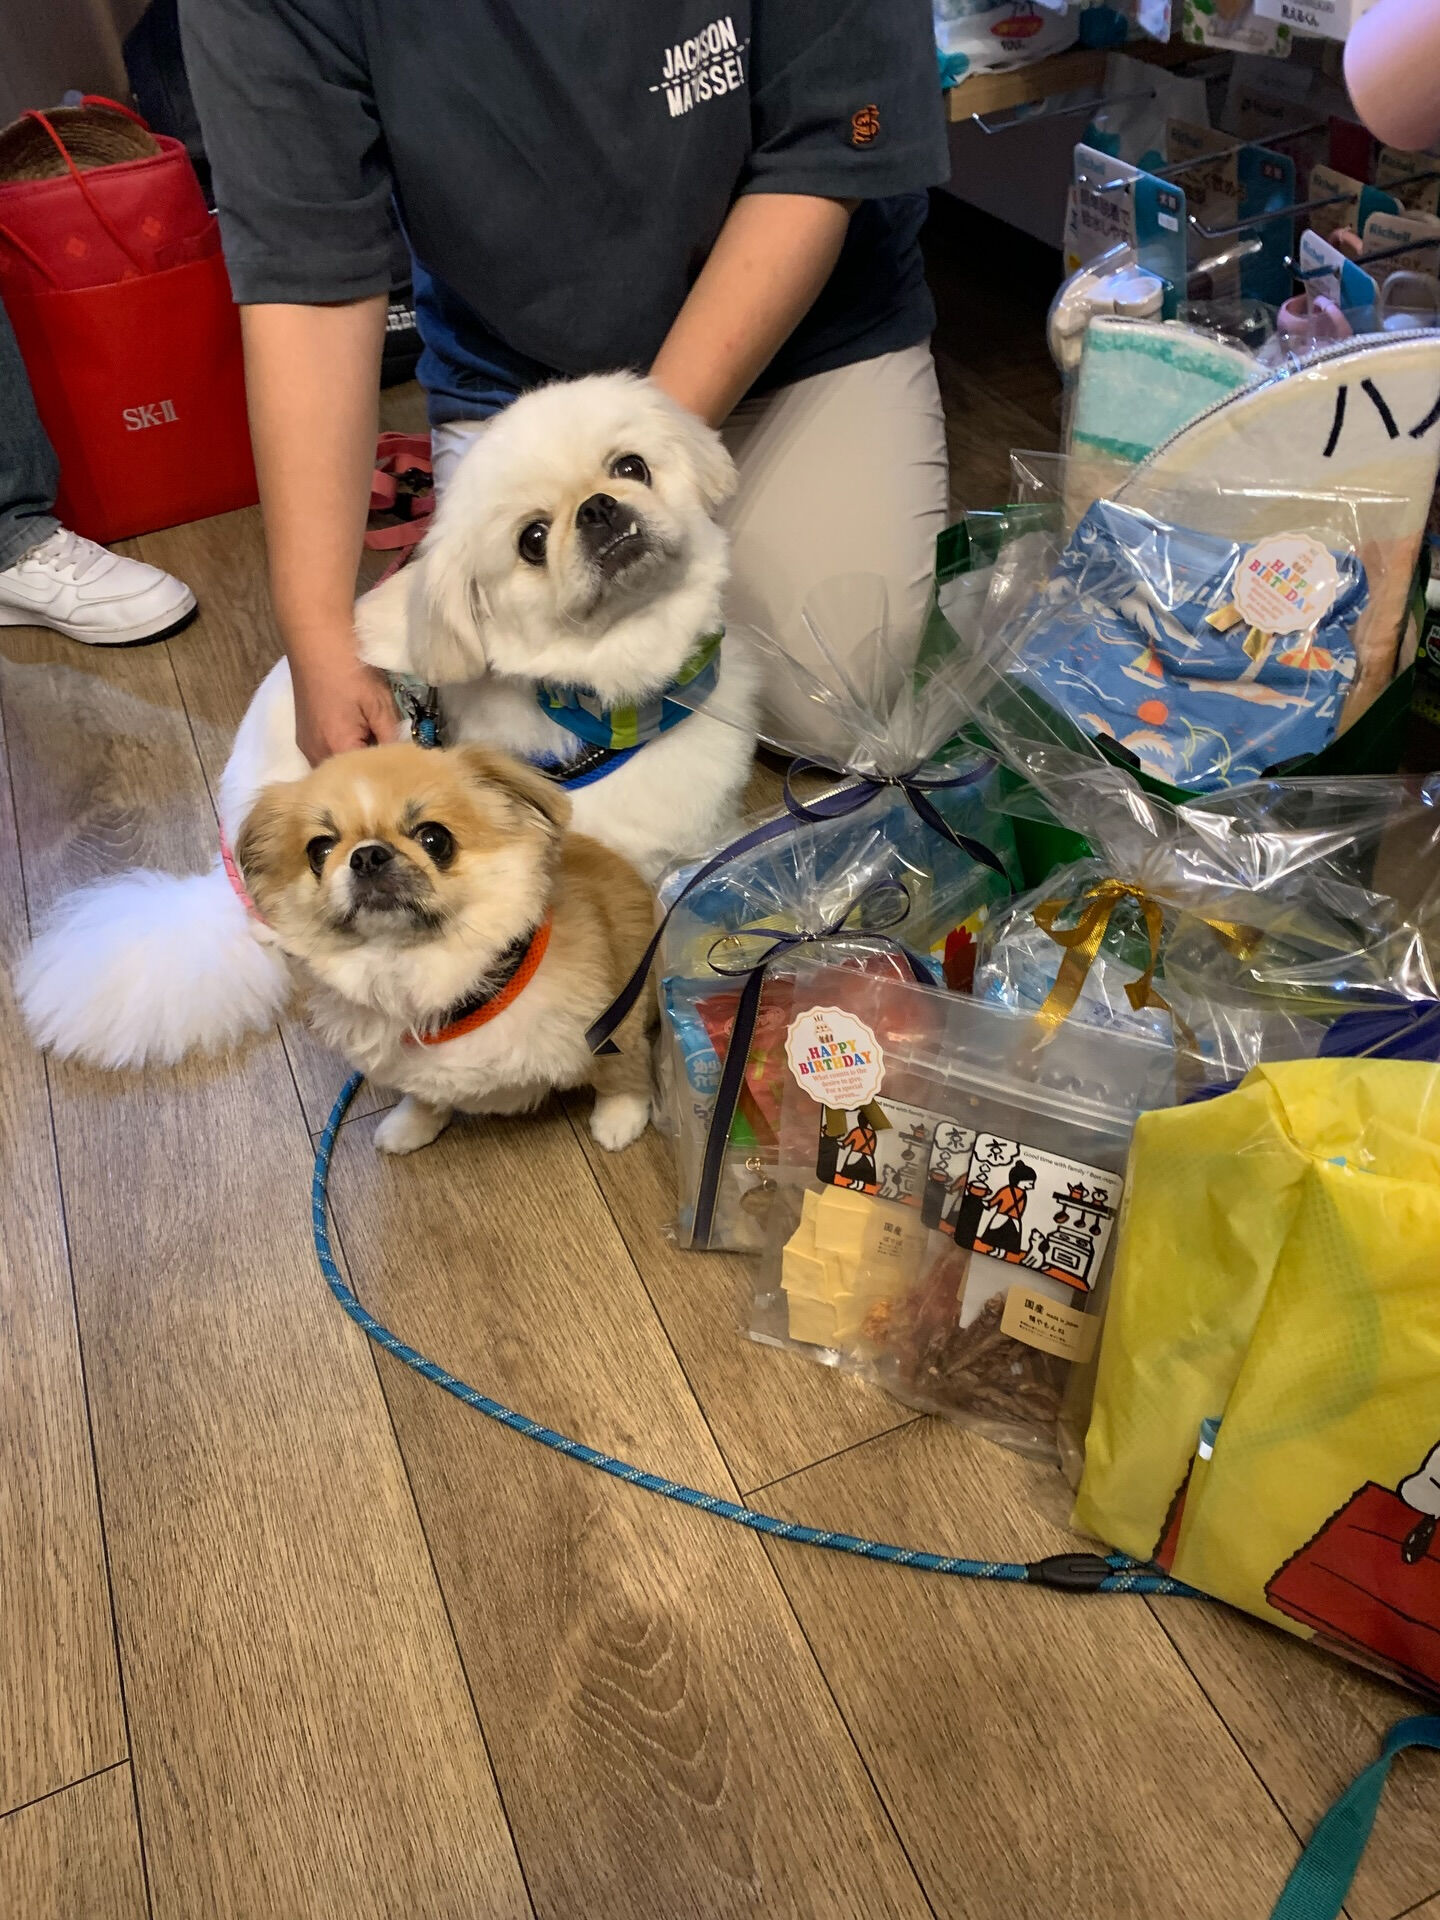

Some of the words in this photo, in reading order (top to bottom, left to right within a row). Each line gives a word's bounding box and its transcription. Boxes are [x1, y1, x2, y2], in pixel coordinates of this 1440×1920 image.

[808, 1039, 857, 1060] HAPPY
[798, 1050, 872, 1075] BIRTHDAY
[945, 1127, 967, 1149] 京
[985, 1138, 1007, 1161] 京
[1023, 1151, 1039, 1161] Good
[1040, 1156, 1053, 1165] time
[1054, 1160, 1067, 1169] with
[1024, 1298, 1044, 1316] 国産
